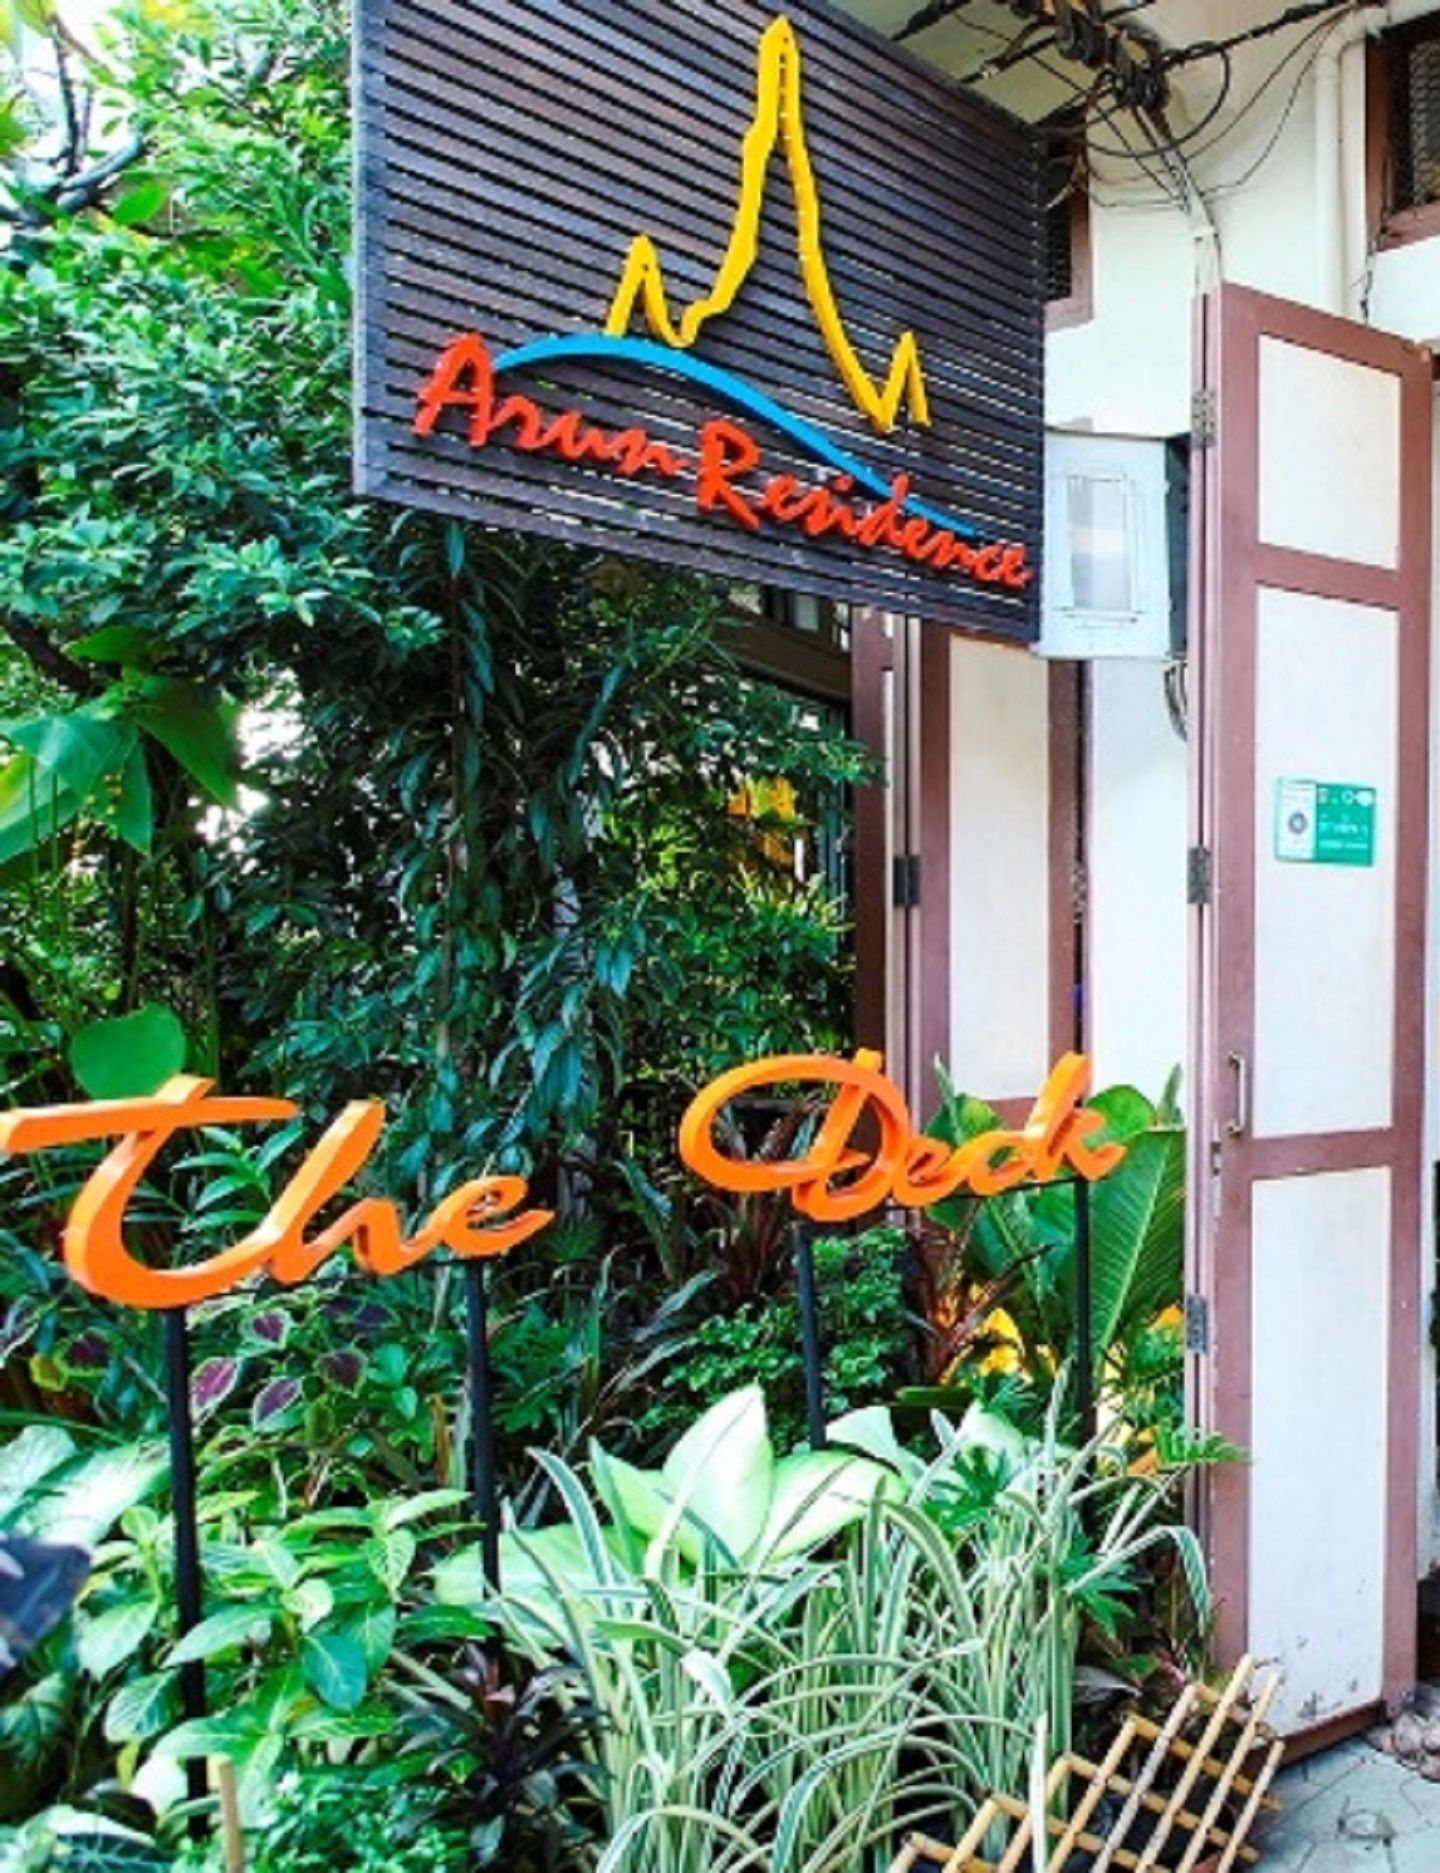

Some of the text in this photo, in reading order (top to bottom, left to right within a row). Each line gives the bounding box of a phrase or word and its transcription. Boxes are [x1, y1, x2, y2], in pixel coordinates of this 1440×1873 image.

[412, 332, 1034, 588] Arun Residence
[0, 1049, 1127, 1310] The Deck
